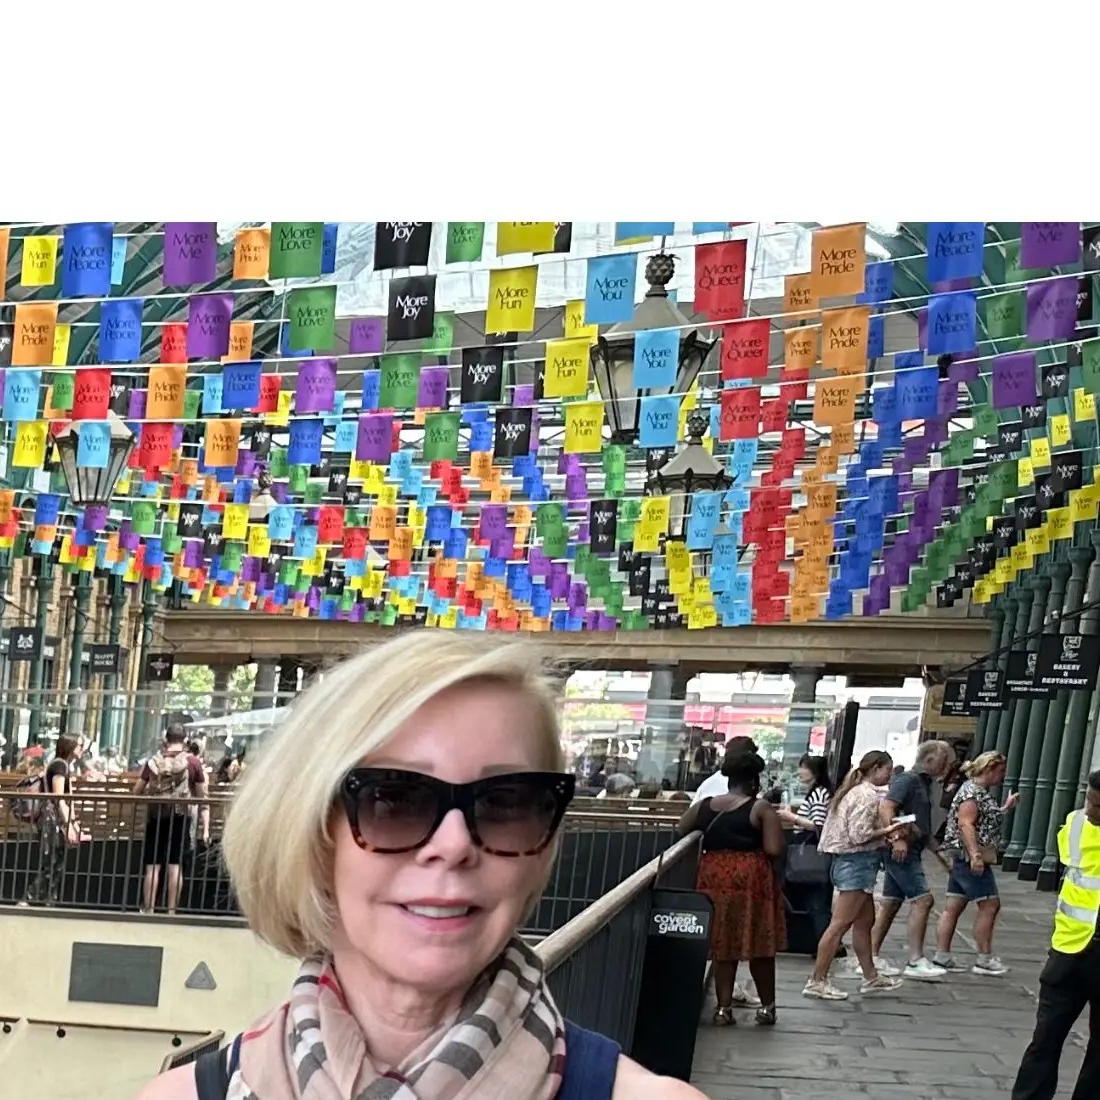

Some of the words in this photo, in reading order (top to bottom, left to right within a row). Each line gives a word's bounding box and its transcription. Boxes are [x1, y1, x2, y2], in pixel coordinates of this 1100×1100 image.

[279, 225, 316, 239] More
[392, 227, 414, 242] Joy
[453, 227, 478, 237] More
[936, 231, 975, 244] More
[1038, 231, 1062, 242] Me
[173, 232, 208, 246] More
[453, 236, 476, 244] Love
[240, 243, 265, 253] More
[281, 239, 311, 251] Love
[935, 244, 975, 257] Peace
[29, 250, 50, 260] More
[72, 245, 104, 257] More
[179, 246, 201, 259] Me
[820, 249, 857, 262] More
[32, 259, 47, 269] Fun
[69, 257, 107, 271] Peace
[703, 264, 738, 275] More
[821, 262, 854, 276] Pride
[594, 277, 628, 290] More
[700, 274, 742, 287] Queer
[496, 287, 528, 299] More
[600, 289, 622, 301] You
[396, 295, 428, 308] More
[501, 299, 522, 310] Fun
[297, 307, 327, 318] More
[402, 307, 421, 319] Joy
[937, 312, 969, 323] More
[108, 317, 135, 328] More
[194, 313, 226, 325] More
[298, 316, 325, 327] Love
[21, 323, 50, 334] More
[201, 325, 219, 335] Me
[829, 327, 861, 336] More
[935, 321, 968, 332] Peace
[105, 328, 135, 339] Peace
[22, 334, 47, 345] Pride
[732, 339, 763, 349] More
[790, 340, 811, 349] More
[830, 337, 859, 348] Pride
[642, 348, 671, 359] More
[728, 348, 764, 360] Queer
[553, 358, 582, 368] More
[647, 358, 666, 368] You
[468, 364, 496, 375] More
[558, 367, 576, 377] Fun
[230, 372, 255, 383] More
[304, 376, 330, 386] More
[386, 371, 414, 381] More
[473, 374, 490, 384] Joy
[155, 382, 180, 392] More
[388, 380, 412, 388] Love
[10, 385, 36, 396] More
[822, 387, 849, 398] More
[13, 393, 29, 403] You
[155, 392, 179, 402] Pride
[822, 397, 848, 407] Pride
[728, 405, 756, 414] More
[647, 412, 672, 421] More
[724, 413, 757, 424] Queer
[501, 424, 525, 434] More
[572, 419, 597, 430] More
[651, 420, 668, 429] You
[83, 436, 106, 444] More
[212, 434, 236, 444] More
[506, 432, 519, 441] Joy
[658, 921, 704, 935] garden
